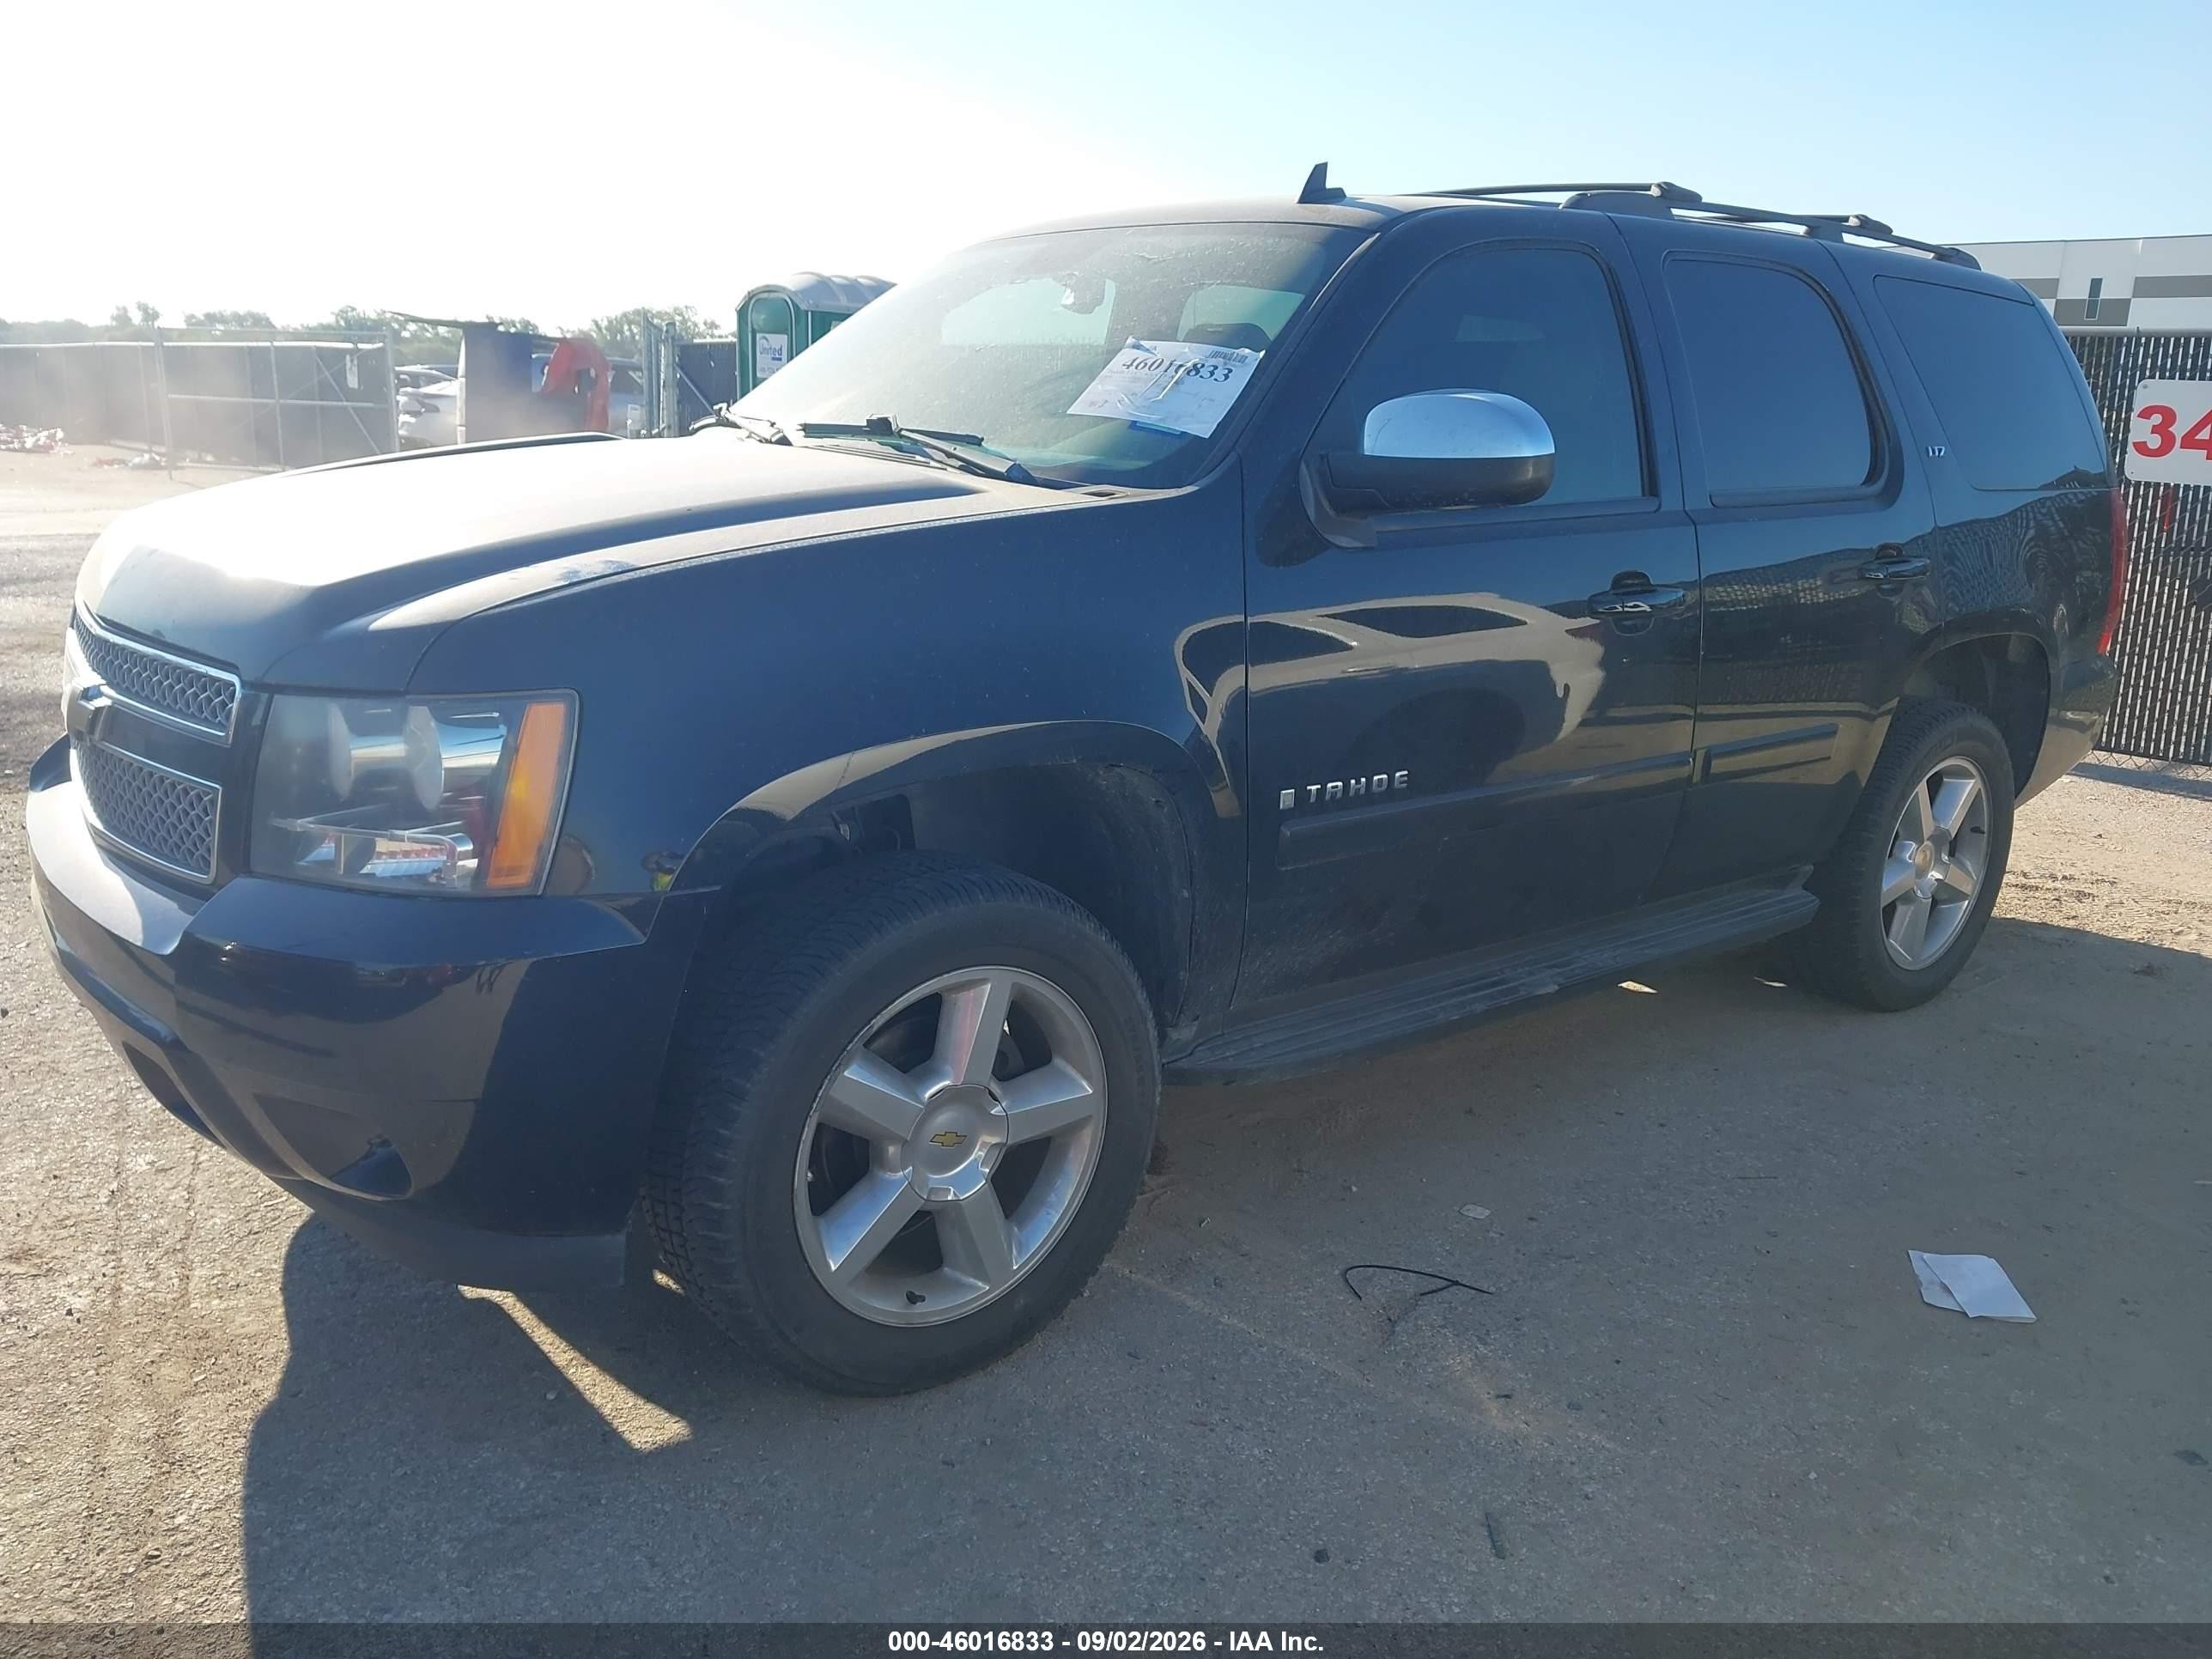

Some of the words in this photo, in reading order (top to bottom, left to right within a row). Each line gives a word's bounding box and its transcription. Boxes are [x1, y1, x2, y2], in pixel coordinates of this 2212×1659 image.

[759, 343, 783, 356] United
[2132, 404, 2212, 461] 34
[1306, 769, 1409, 803] TAHOE
